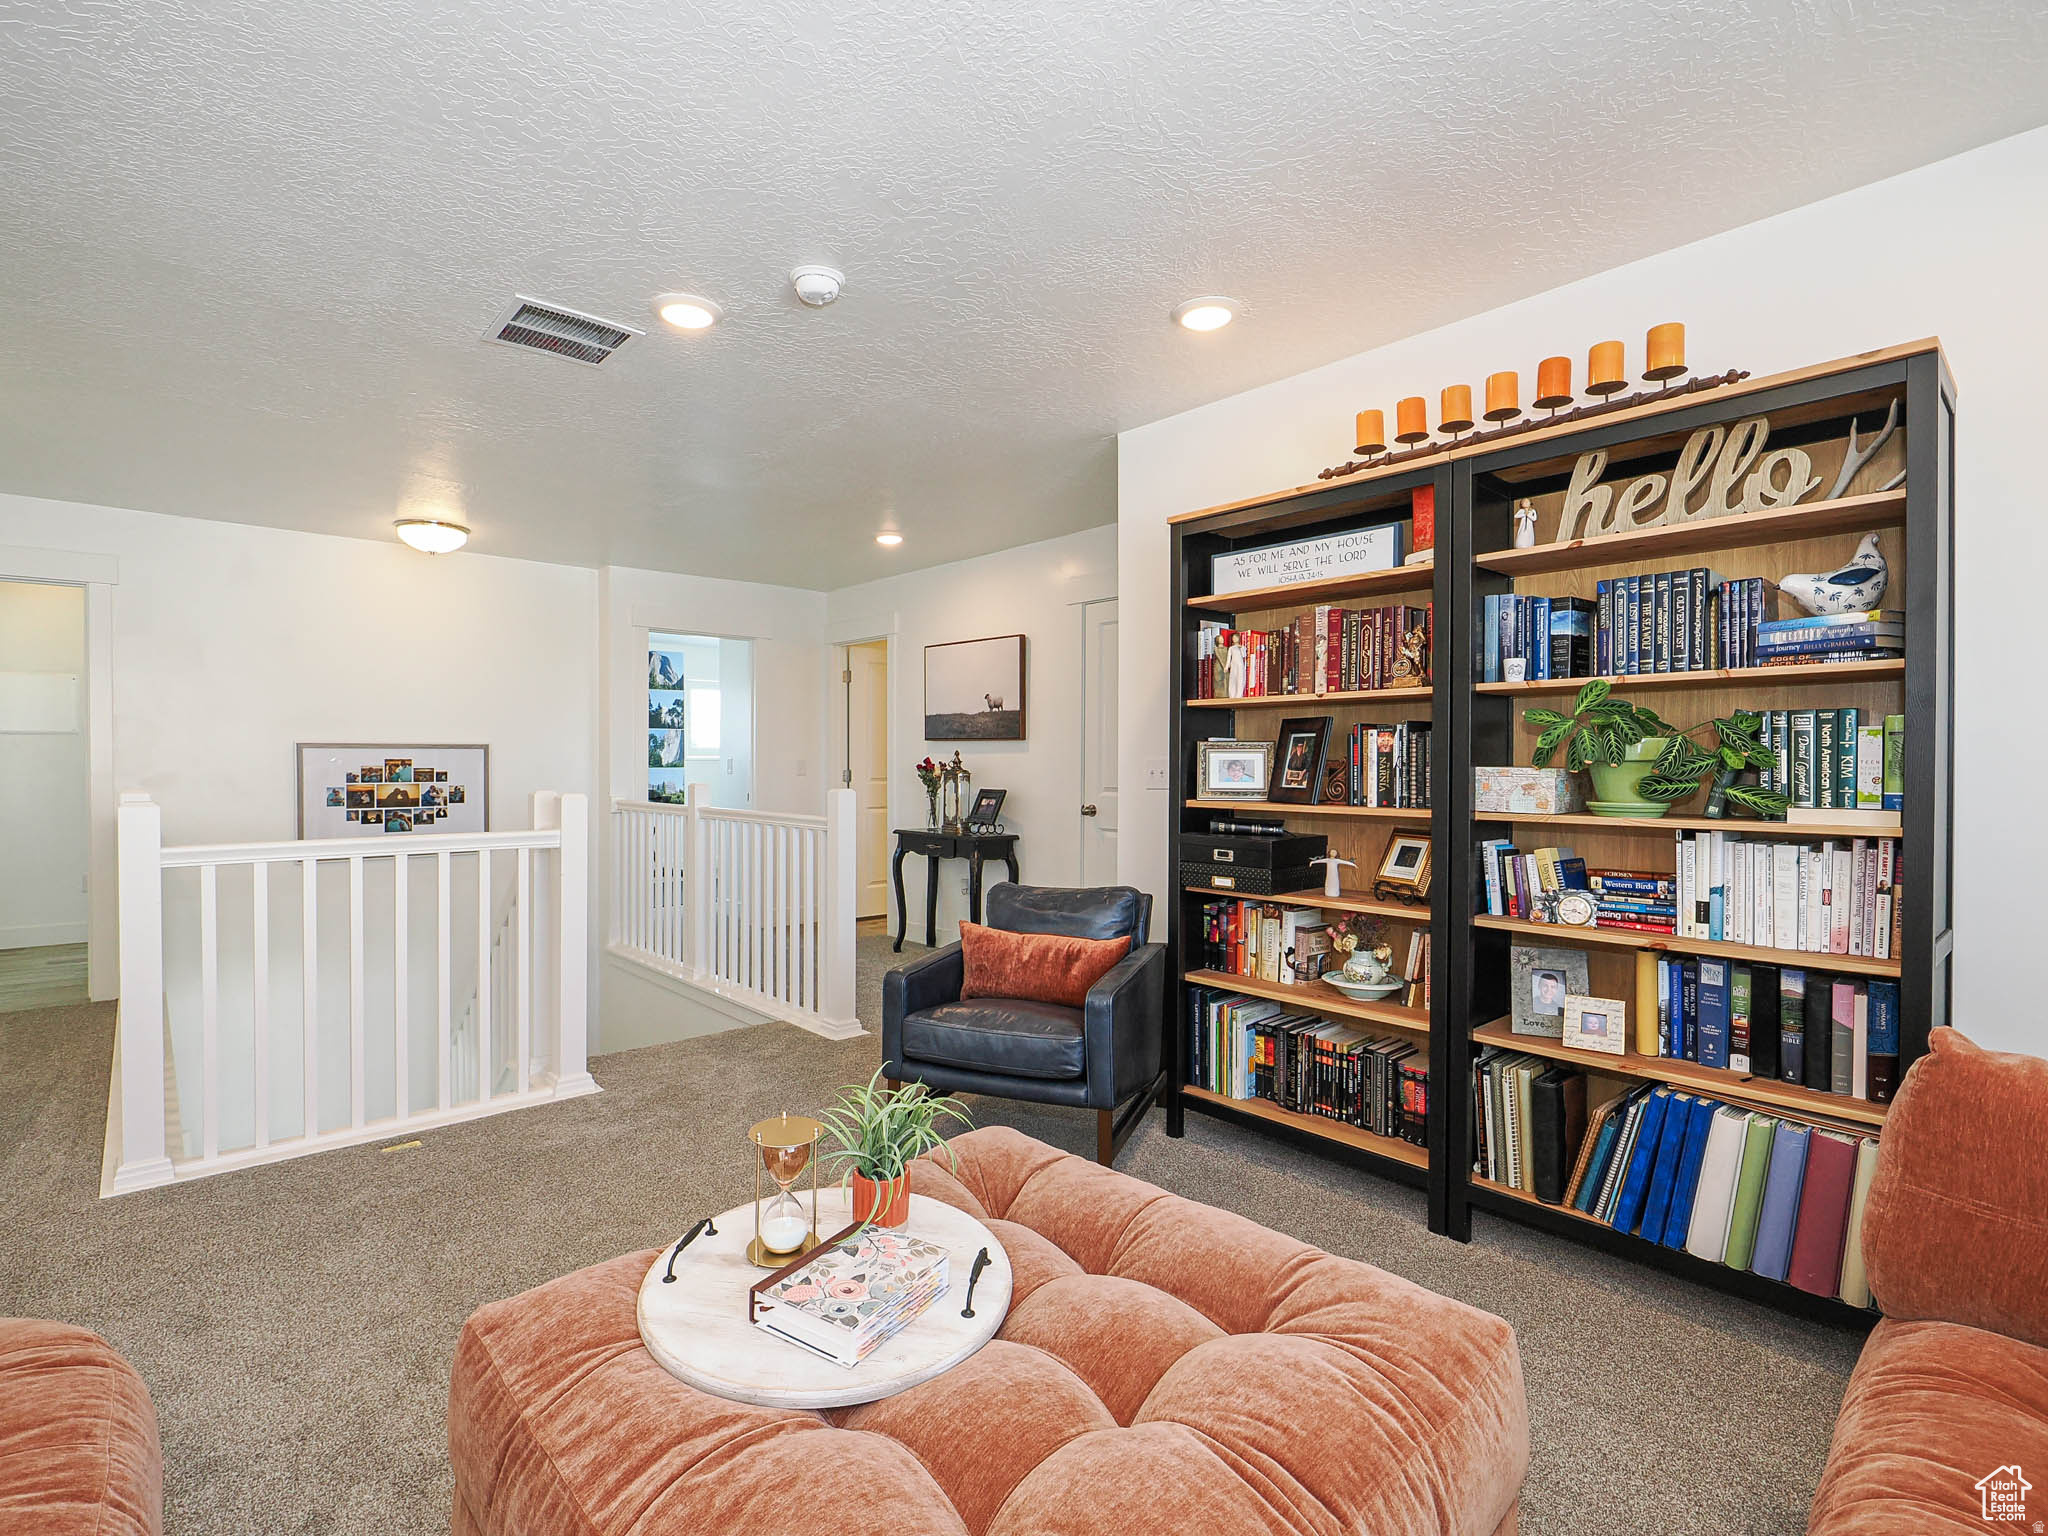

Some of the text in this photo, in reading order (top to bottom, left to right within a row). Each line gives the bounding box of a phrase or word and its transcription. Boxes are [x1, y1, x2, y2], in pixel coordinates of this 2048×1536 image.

[1556, 415, 1823, 543] hello
[1234, 534, 1374, 566] AS FOR ME AND MY HOUSE
[1238, 550, 1367, 578] WE WILL SERVE THE LORD
[1629, 602, 1638, 620] LOST
[1642, 601, 1651, 650] THE SEA WOLF
[1676, 596, 1684, 649] OLIVER TWIST
[1776, 640, 1856, 652] Journey BILLY GRAHAM
[1798, 736, 1809, 759] David
[1821, 724, 1832, 746] North
[1795, 761, 1809, 797] Copperfield
[1821, 748, 1832, 789] American
[1841, 756, 1853, 778] KIM
[1686, 845, 1694, 883] KINGSBURY
[1605, 880, 1632, 889] Western
